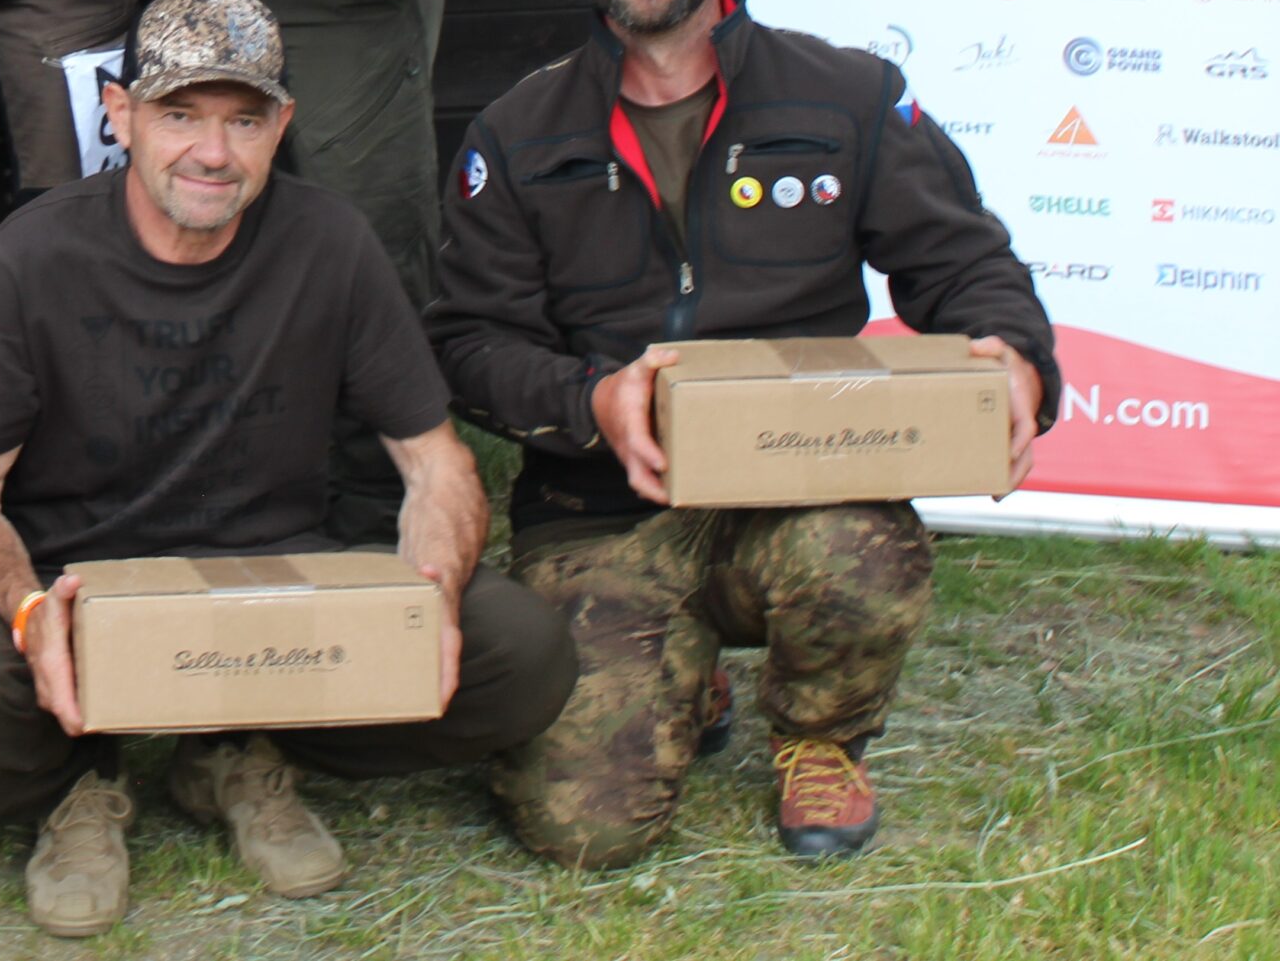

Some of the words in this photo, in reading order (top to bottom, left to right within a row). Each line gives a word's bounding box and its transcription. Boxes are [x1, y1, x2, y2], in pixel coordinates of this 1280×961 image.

[1182, 128, 1280, 150] Walkstool
[1180, 205, 1276, 224] HIKMICRO
[1155, 263, 1262, 291] Delphin
[1062, 382, 1210, 431] N.com
[755, 430, 821, 451] Sellier
[838, 427, 899, 448] Bellot
[173, 649, 243, 671] Sellier
[259, 646, 326, 667] Bellot
